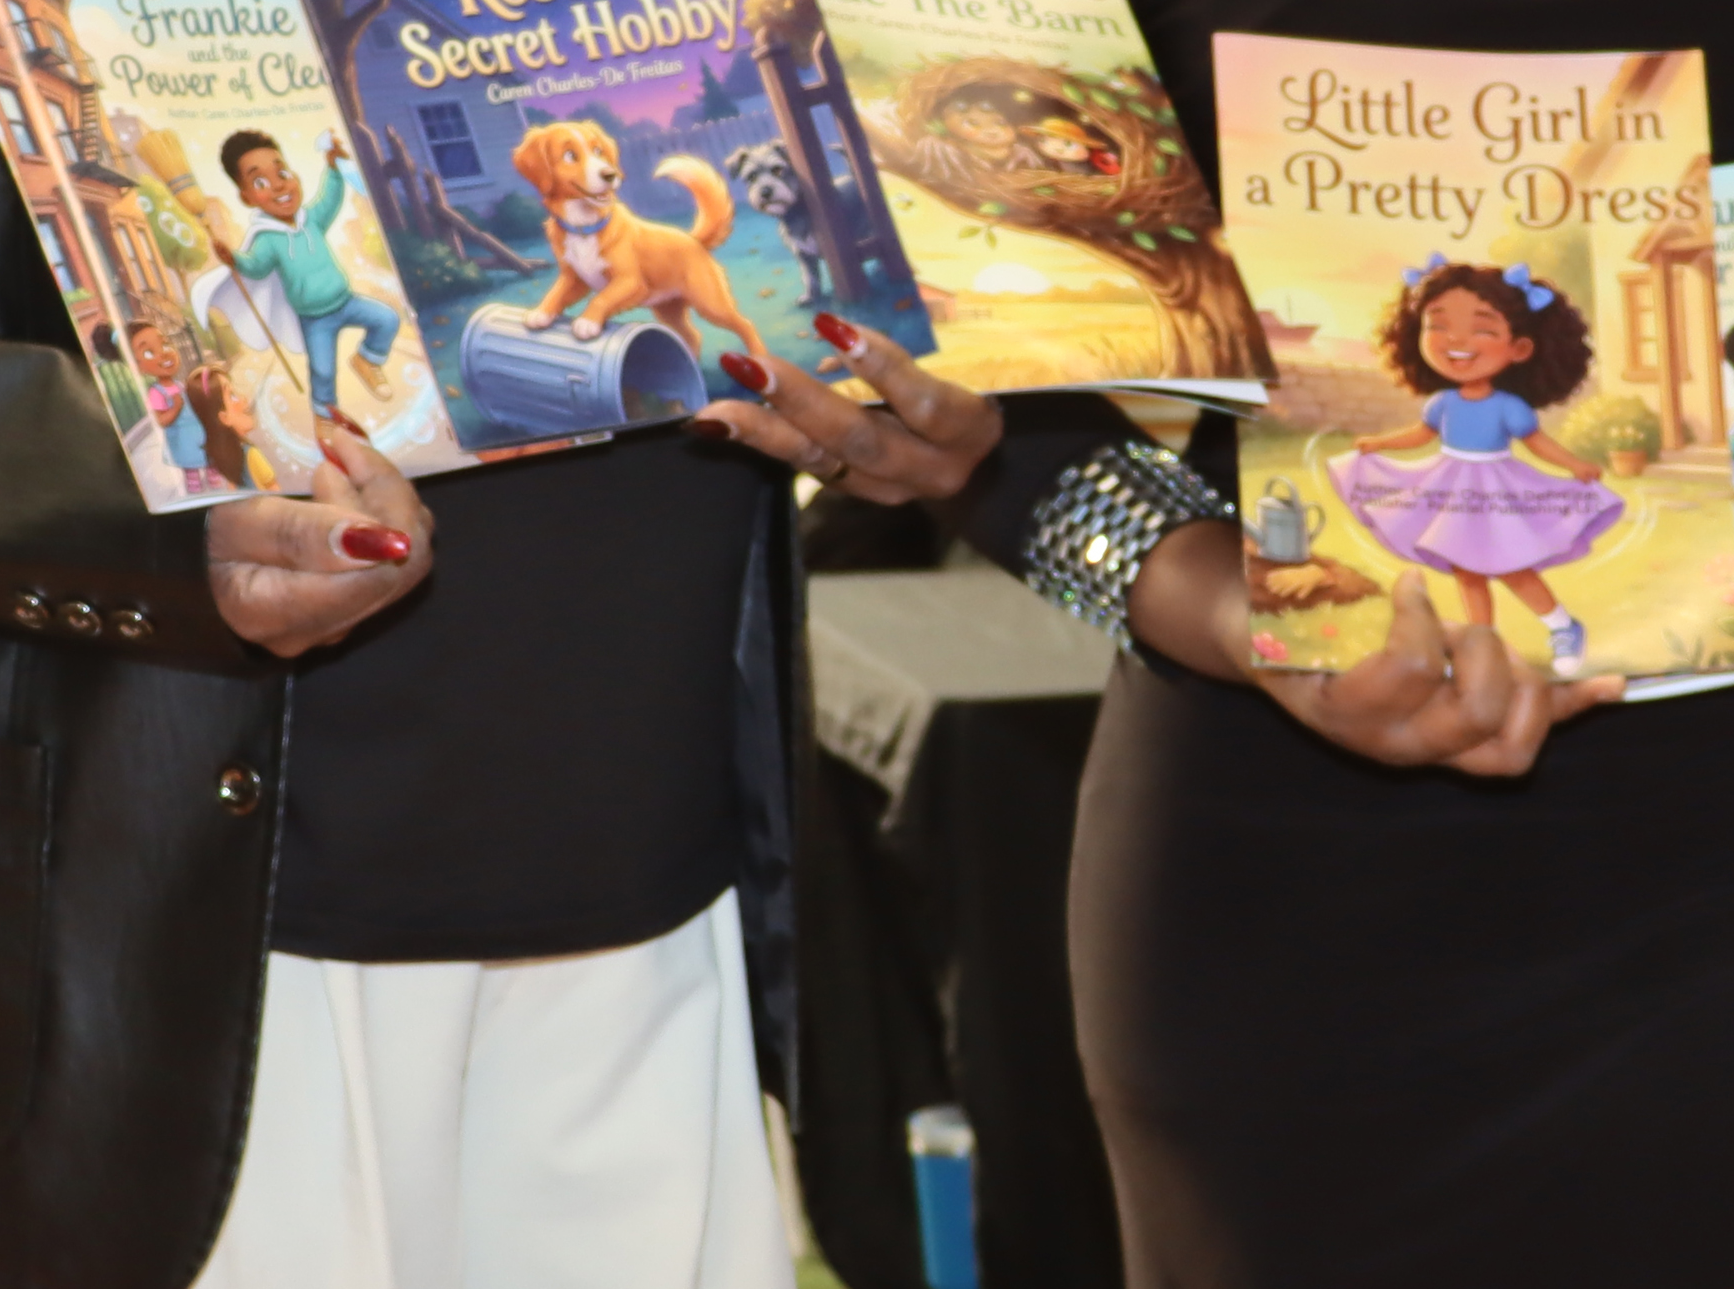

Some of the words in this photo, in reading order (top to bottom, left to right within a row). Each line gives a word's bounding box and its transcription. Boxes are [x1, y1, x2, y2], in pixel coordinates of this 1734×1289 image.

[111, 54, 217, 97] Power
[228, 66, 253, 101] of
[188, 44, 219, 62] and
[223, 42, 251, 62] the
[401, 18, 566, 89] Secret
[486, 80, 533, 105] Caren
[626, 58, 684, 83] Freitas
[1279, 67, 1453, 152] Little
[1471, 81, 1596, 164] Girl
[1615, 103, 1667, 143] in
[1245, 173, 1274, 206] a
[1283, 149, 1487, 240] Pretty
[1502, 163, 1703, 230] Dress
